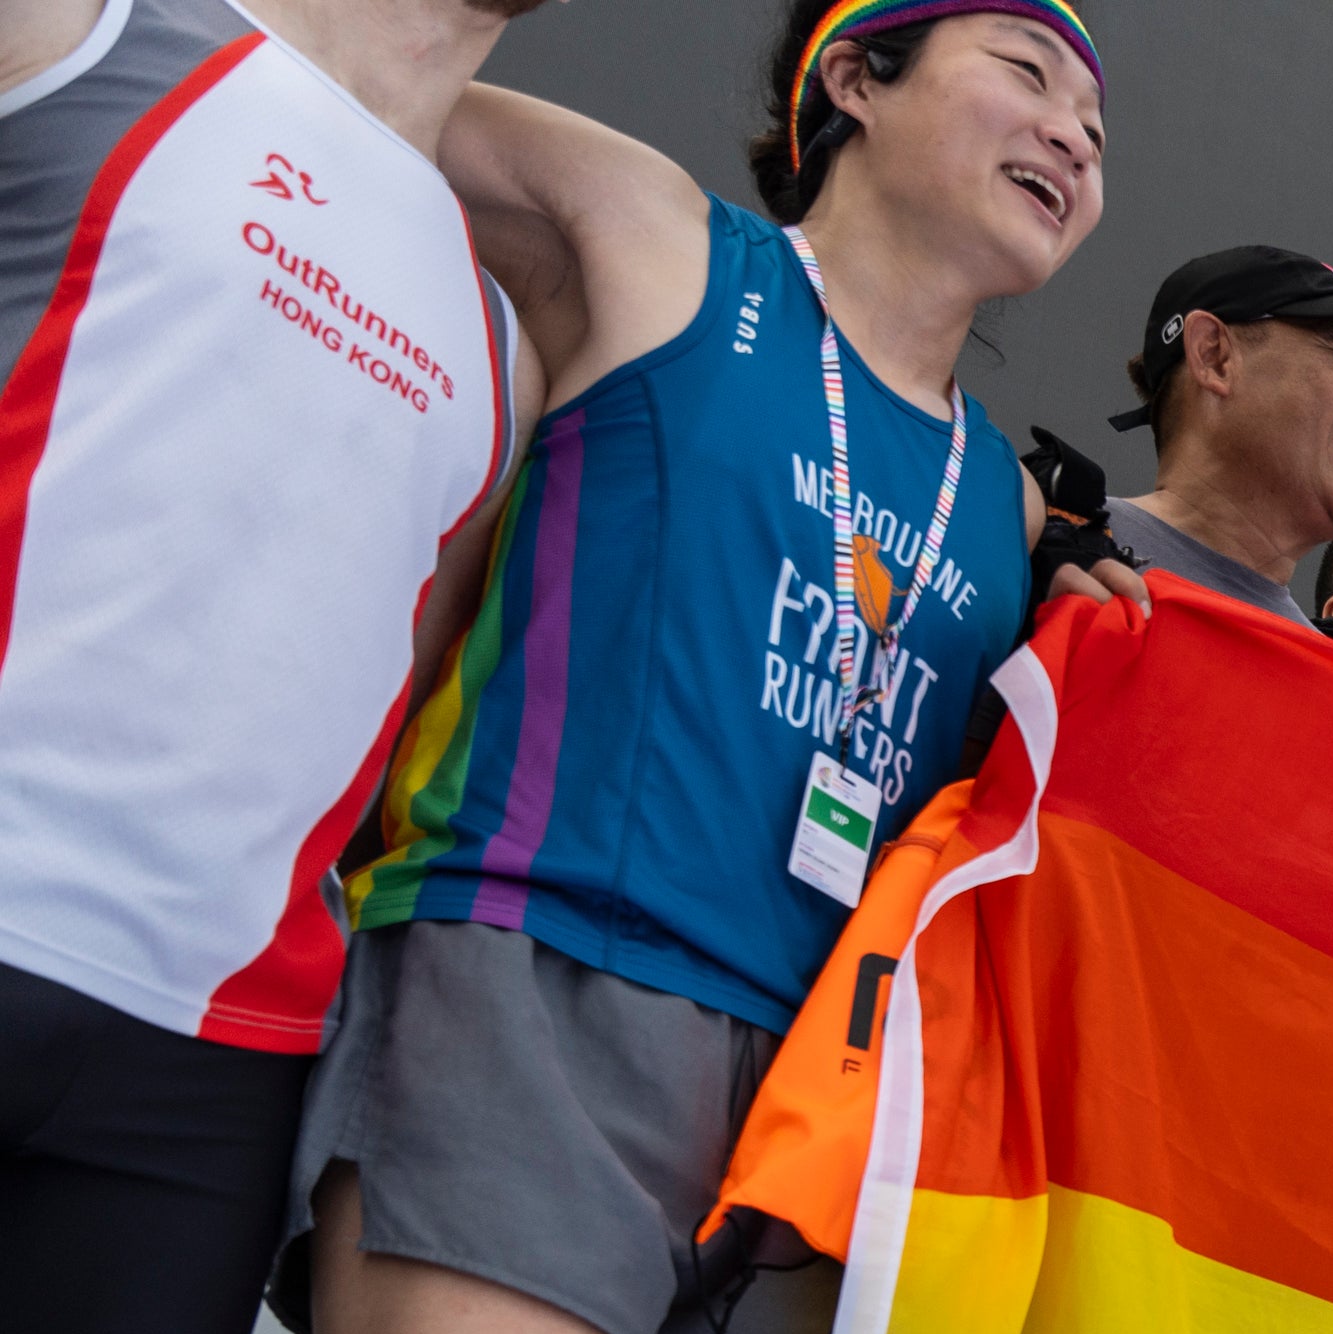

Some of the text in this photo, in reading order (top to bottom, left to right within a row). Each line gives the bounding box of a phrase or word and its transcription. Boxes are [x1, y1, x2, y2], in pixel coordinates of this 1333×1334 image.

[242, 221, 454, 400] OutRunners
[260, 280, 430, 413] HONG KONG
[792, 453, 978, 620] MEBOUNE
[761, 651, 913, 806] RUNERS
[830, 809, 849, 826] VIP
